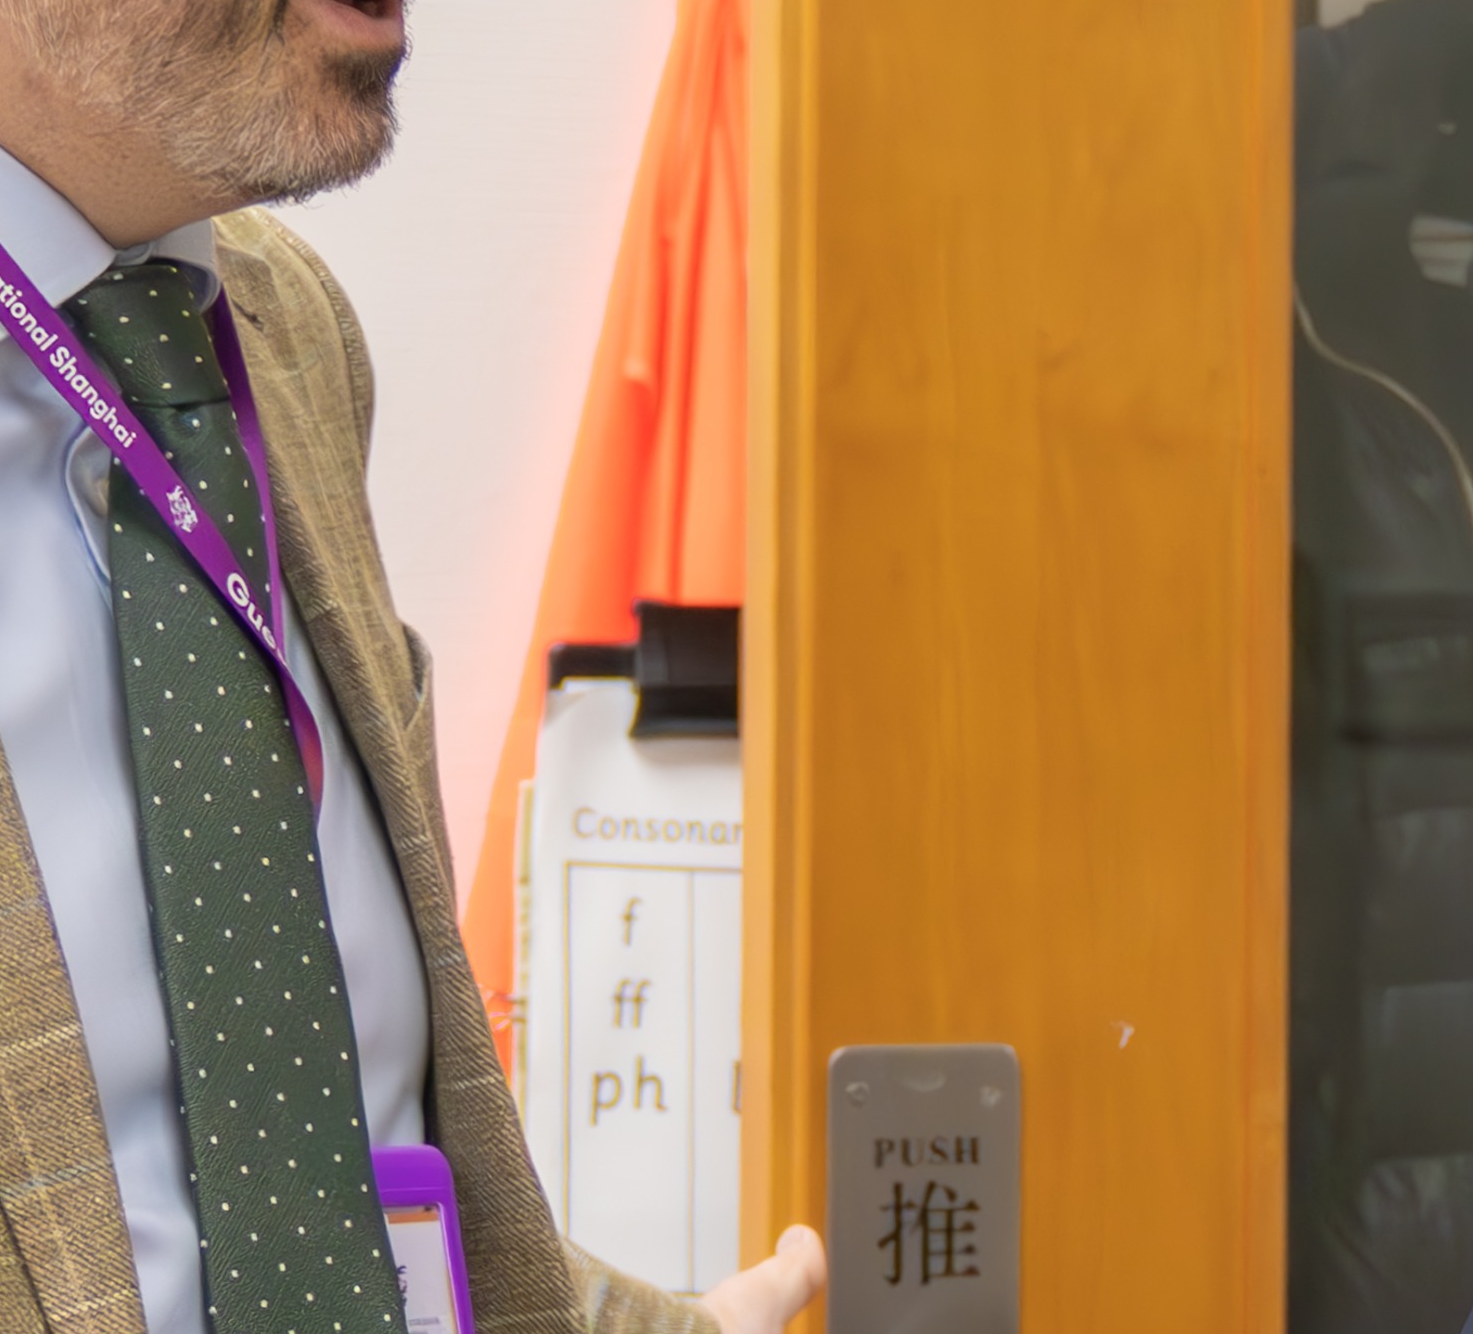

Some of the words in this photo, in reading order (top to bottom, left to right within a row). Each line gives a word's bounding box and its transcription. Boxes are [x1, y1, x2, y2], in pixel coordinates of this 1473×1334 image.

[48, 345, 138, 449] Shanghai
[621, 896, 644, 947] f
[612, 977, 652, 1029] ff
[590, 1054, 668, 1128] ph
[874, 1135, 980, 1169] PUSH
[878, 1180, 981, 1288] 推
